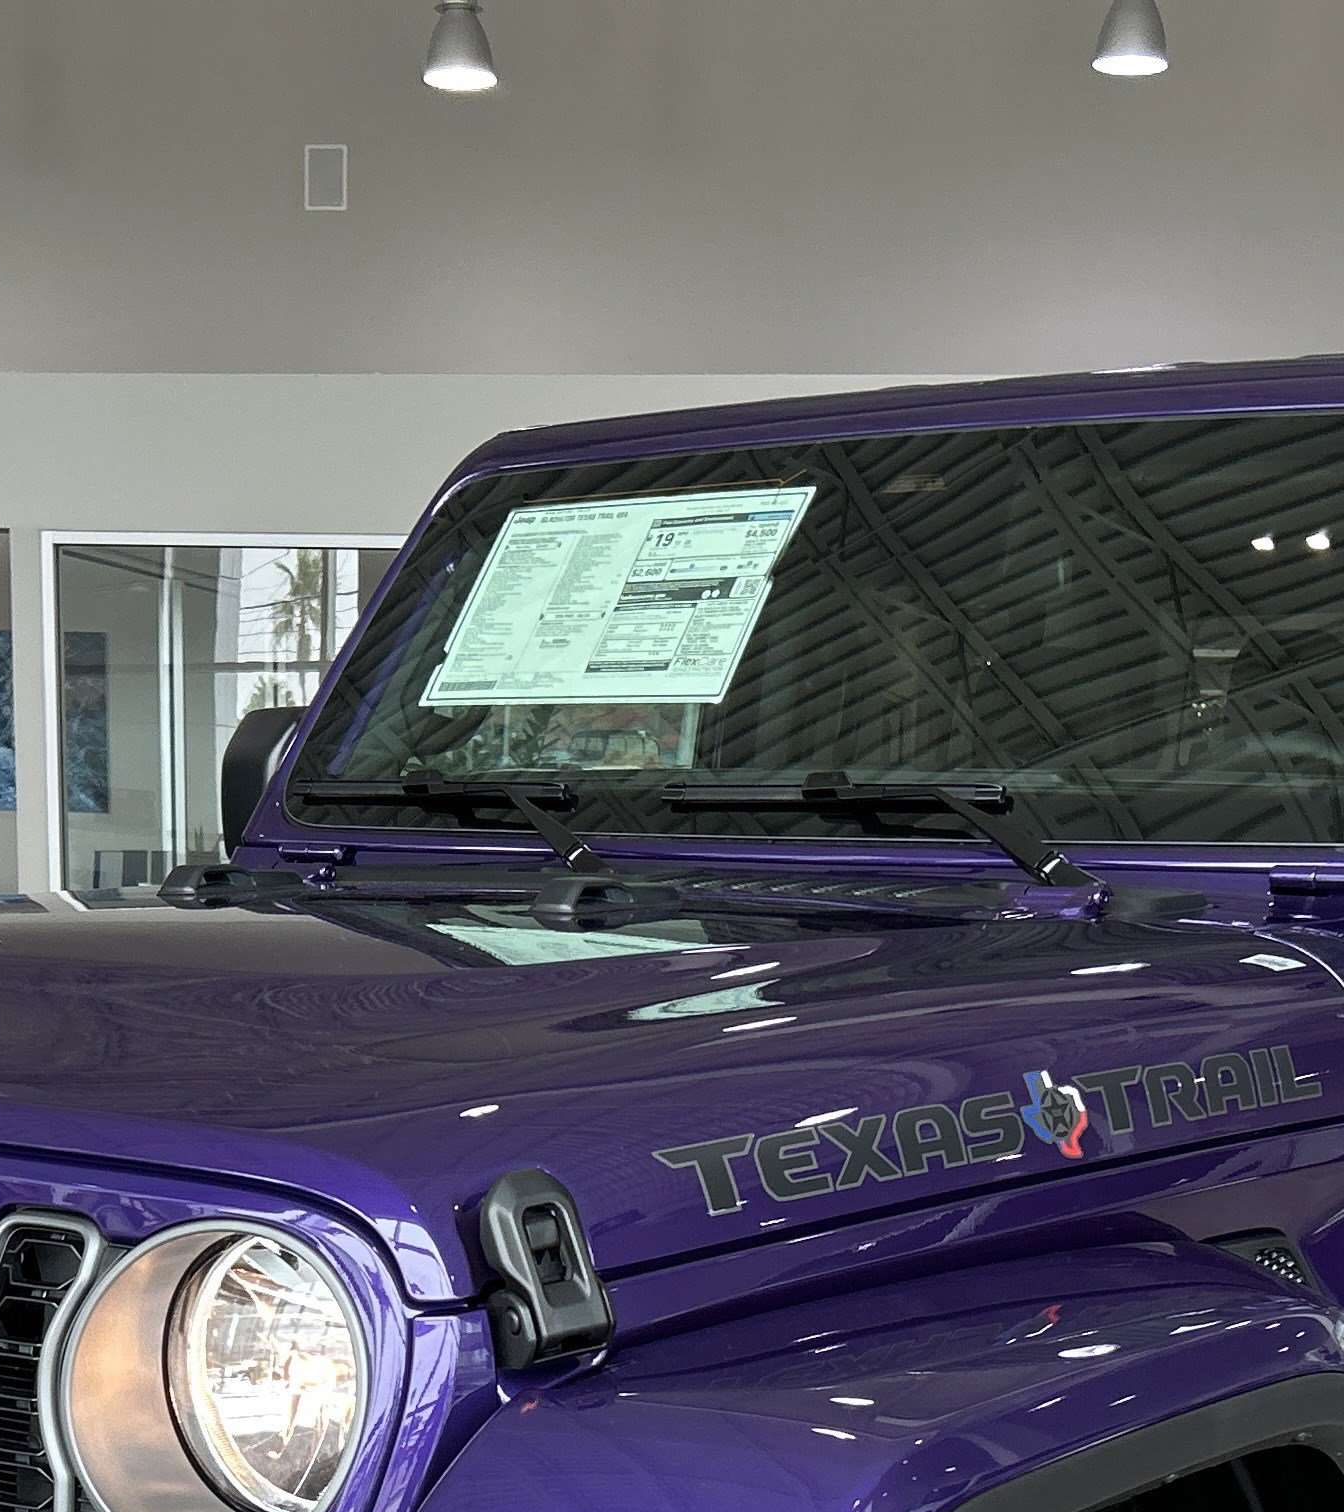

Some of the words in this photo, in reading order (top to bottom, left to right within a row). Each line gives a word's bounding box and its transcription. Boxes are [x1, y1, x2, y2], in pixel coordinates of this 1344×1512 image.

[655, 532, 675, 548] 19
[652, 1091, 1025, 1217] TEXAS
[1072, 1044, 1323, 1134] TRAIL
